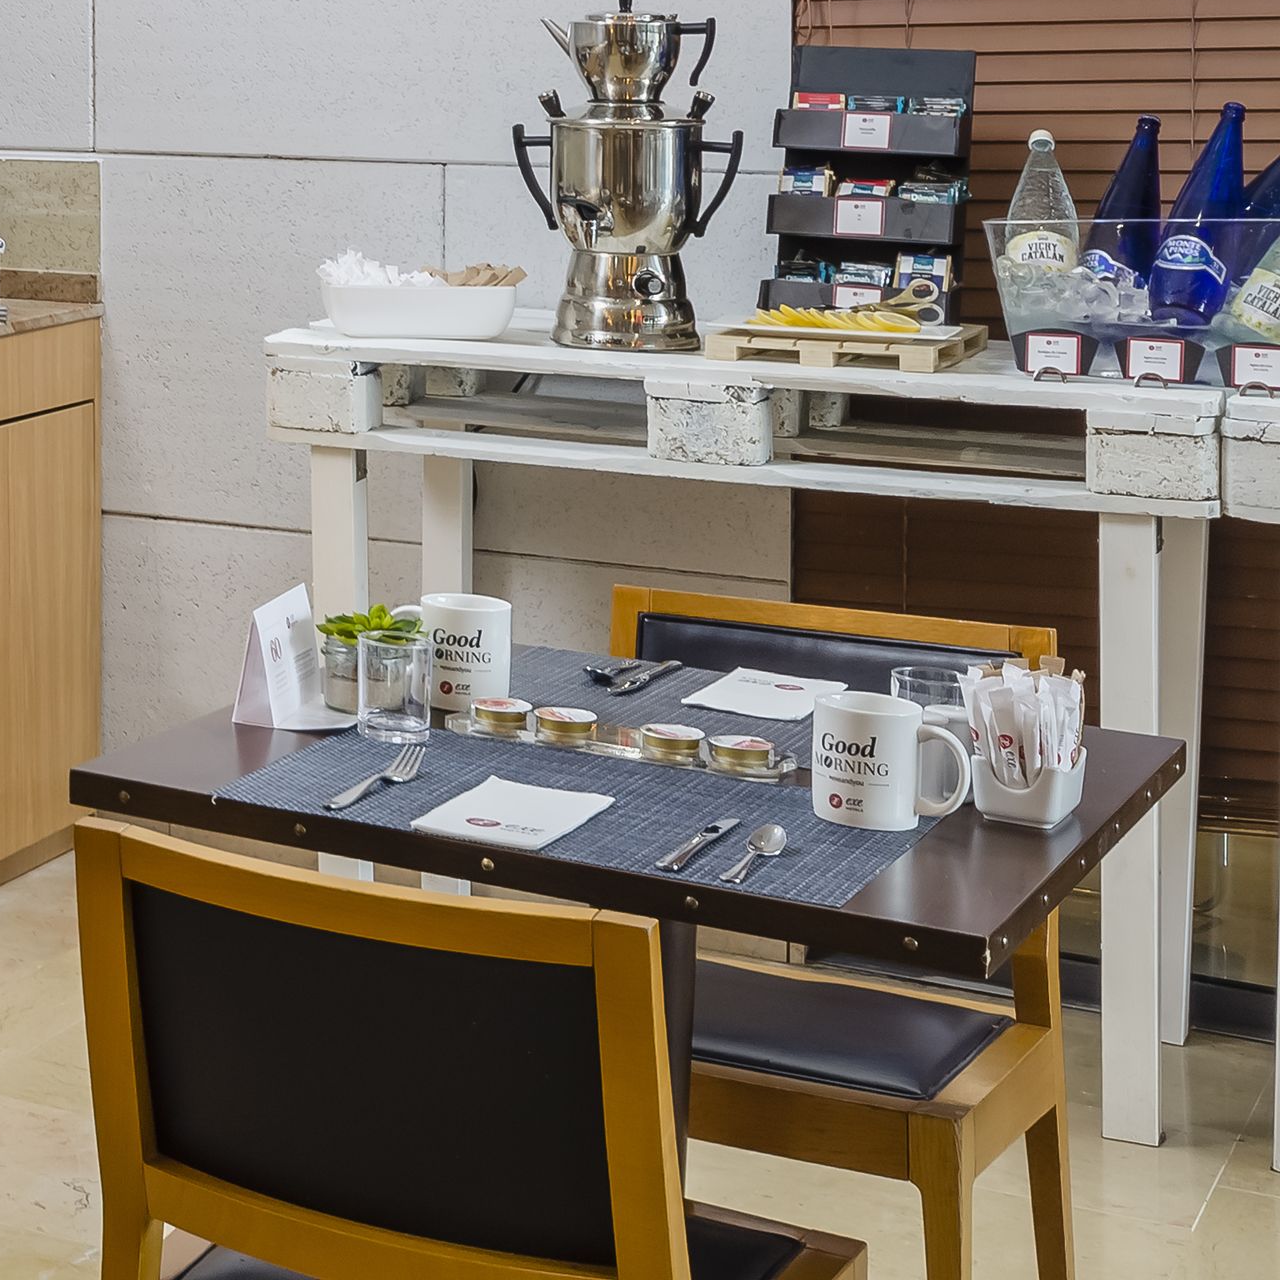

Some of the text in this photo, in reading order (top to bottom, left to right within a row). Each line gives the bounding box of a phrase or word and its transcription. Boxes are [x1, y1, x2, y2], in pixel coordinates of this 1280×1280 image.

[1027, 241, 1058, 253] VICHY
[1167, 238, 1201, 251] MONTE
[1169, 246, 1199, 257] PINOS
[1021, 250, 1065, 264] CATALAN
[1257, 283, 1280, 304] VICH
[433, 628, 482, 648] Good
[432, 647, 492, 664] ORNING
[821, 732, 877, 758] Good
[815, 751, 889, 777] MORNING
